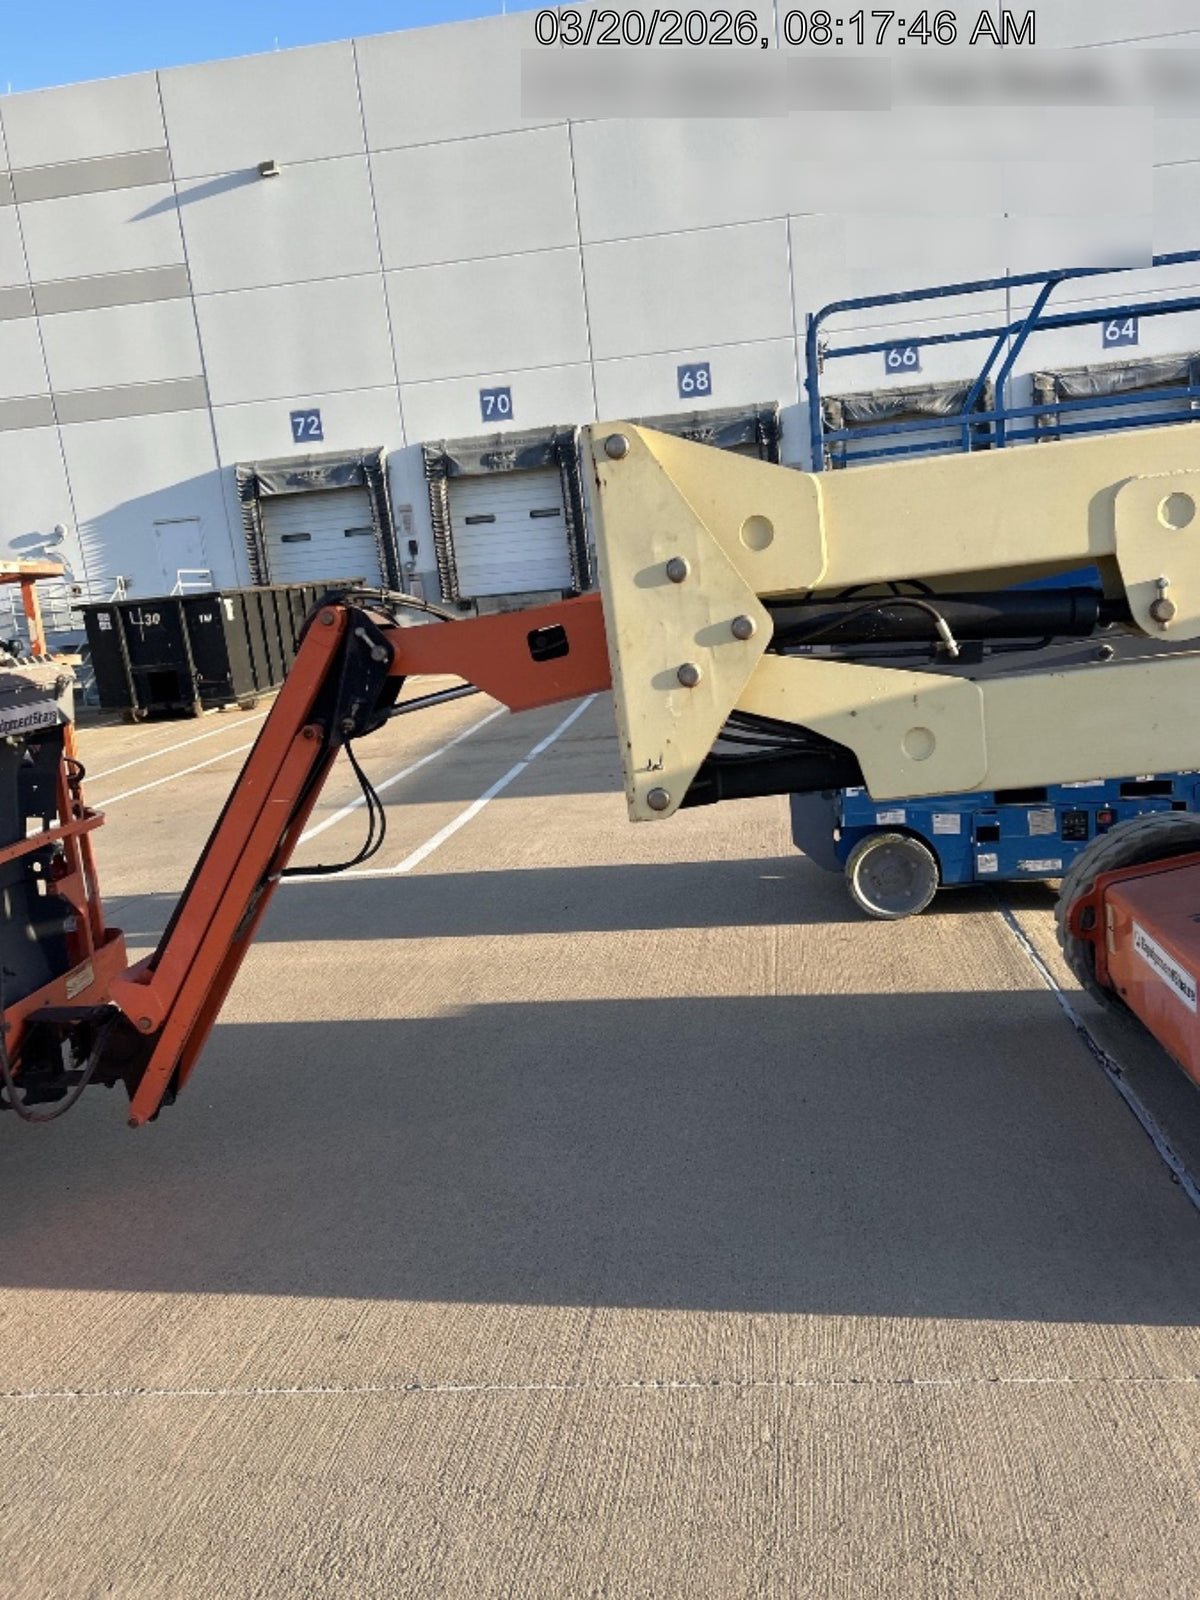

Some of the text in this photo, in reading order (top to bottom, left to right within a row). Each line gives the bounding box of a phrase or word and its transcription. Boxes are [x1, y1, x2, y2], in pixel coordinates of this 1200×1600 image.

[1105, 318, 1136, 340] 64
[888, 346, 916, 367] 66
[681, 370, 708, 392] 68
[483, 394, 510, 415] 70
[293, 416, 320, 436] 72
